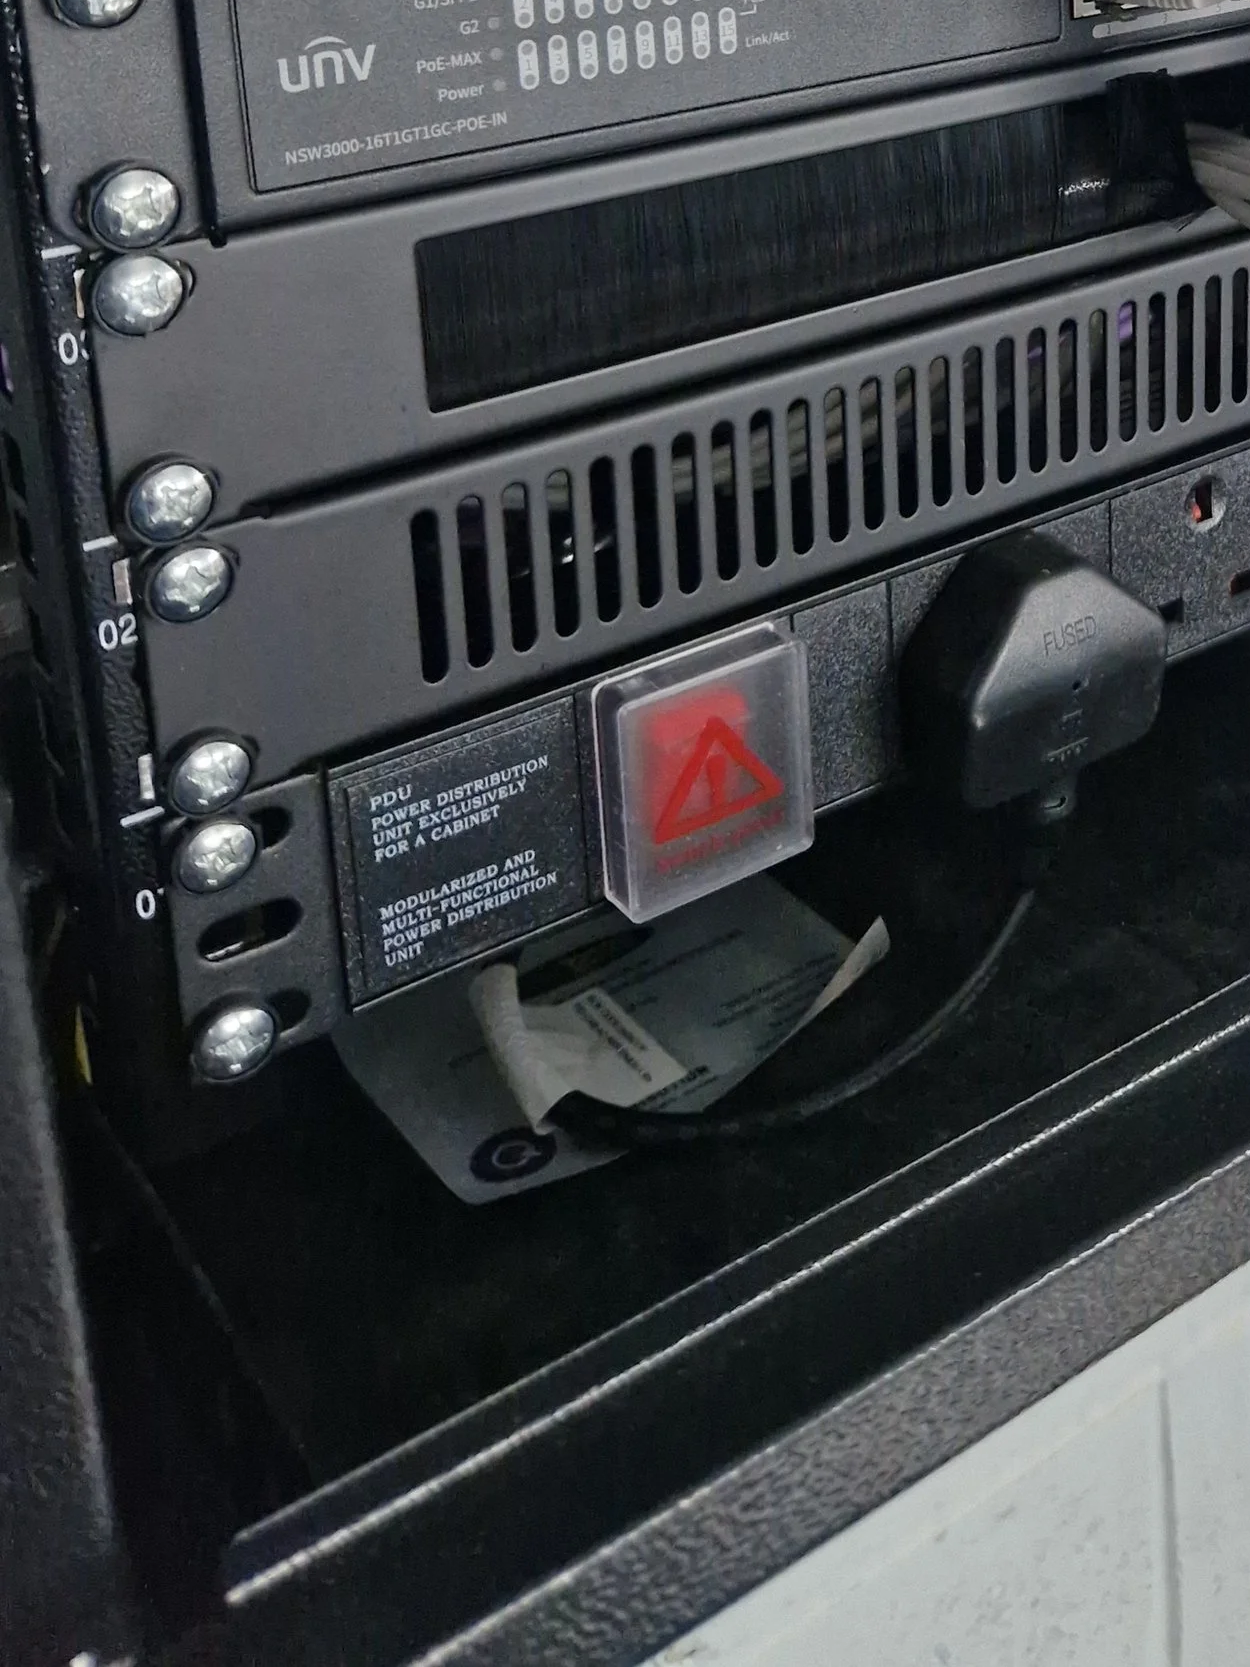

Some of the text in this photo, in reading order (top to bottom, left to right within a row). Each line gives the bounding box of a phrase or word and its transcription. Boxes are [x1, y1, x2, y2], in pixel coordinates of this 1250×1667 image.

[459, 20, 480, 35] G2
[525, 59, 532, 71] 1
[556, 54, 563, 66] 3
[584, 48, 592, 60] 5
[612, 44, 621, 55] 7
[642, 39, 650, 51] 9
[667, 36, 680, 47] 11
[721, 25, 735, 37] 15
[745, 30, 790, 48] Link/Act
[416, 51, 483, 74] PoE-MAX
[438, 84, 485, 103] Power
[285, 111, 508, 166] NSW3000-16T1GT1GC-POE-IN
[58, 329, 90, 366] 0
[98, 612, 137, 652] 02
[1043, 614, 1097, 657] FUSED
[370, 784, 412, 812] PDU
[371, 754, 549, 832] POWER DISTRIBUTION
[373, 777, 527, 847] UNIT EXCLUSIVELY
[374, 804, 501, 863] FOR A CABINET
[378, 849, 536, 922] MODULARIZED AND
[381, 864, 540, 937] MULTI-FUNCTIONAL
[383, 871, 558, 953] POWER DISTRIBUTION
[384, 941, 425, 967] UNIT
